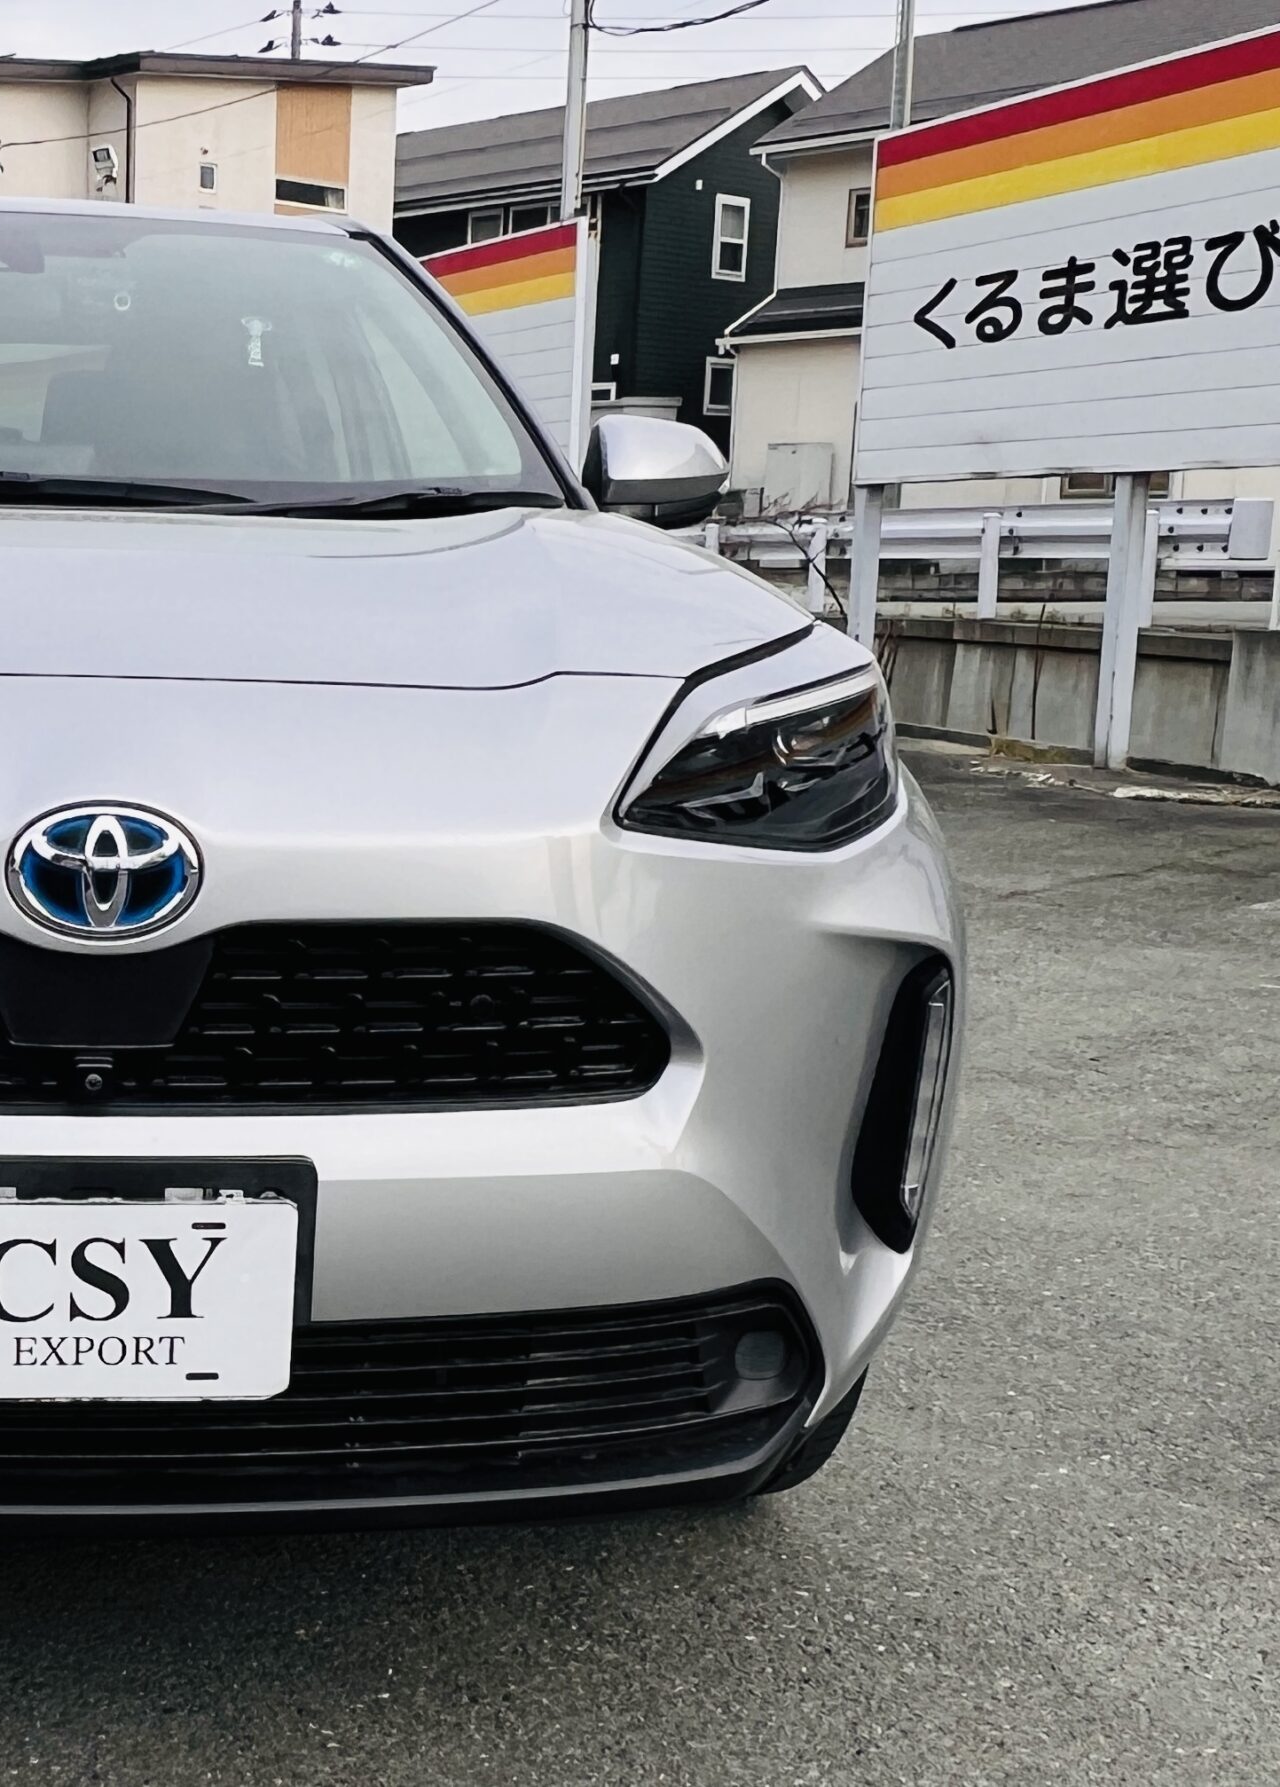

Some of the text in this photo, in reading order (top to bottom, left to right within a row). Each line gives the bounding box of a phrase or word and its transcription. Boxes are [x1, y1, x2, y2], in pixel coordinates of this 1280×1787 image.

[914, 219, 1280, 350] くるま選び
[13, 1336, 186, 1366] EXPORT
